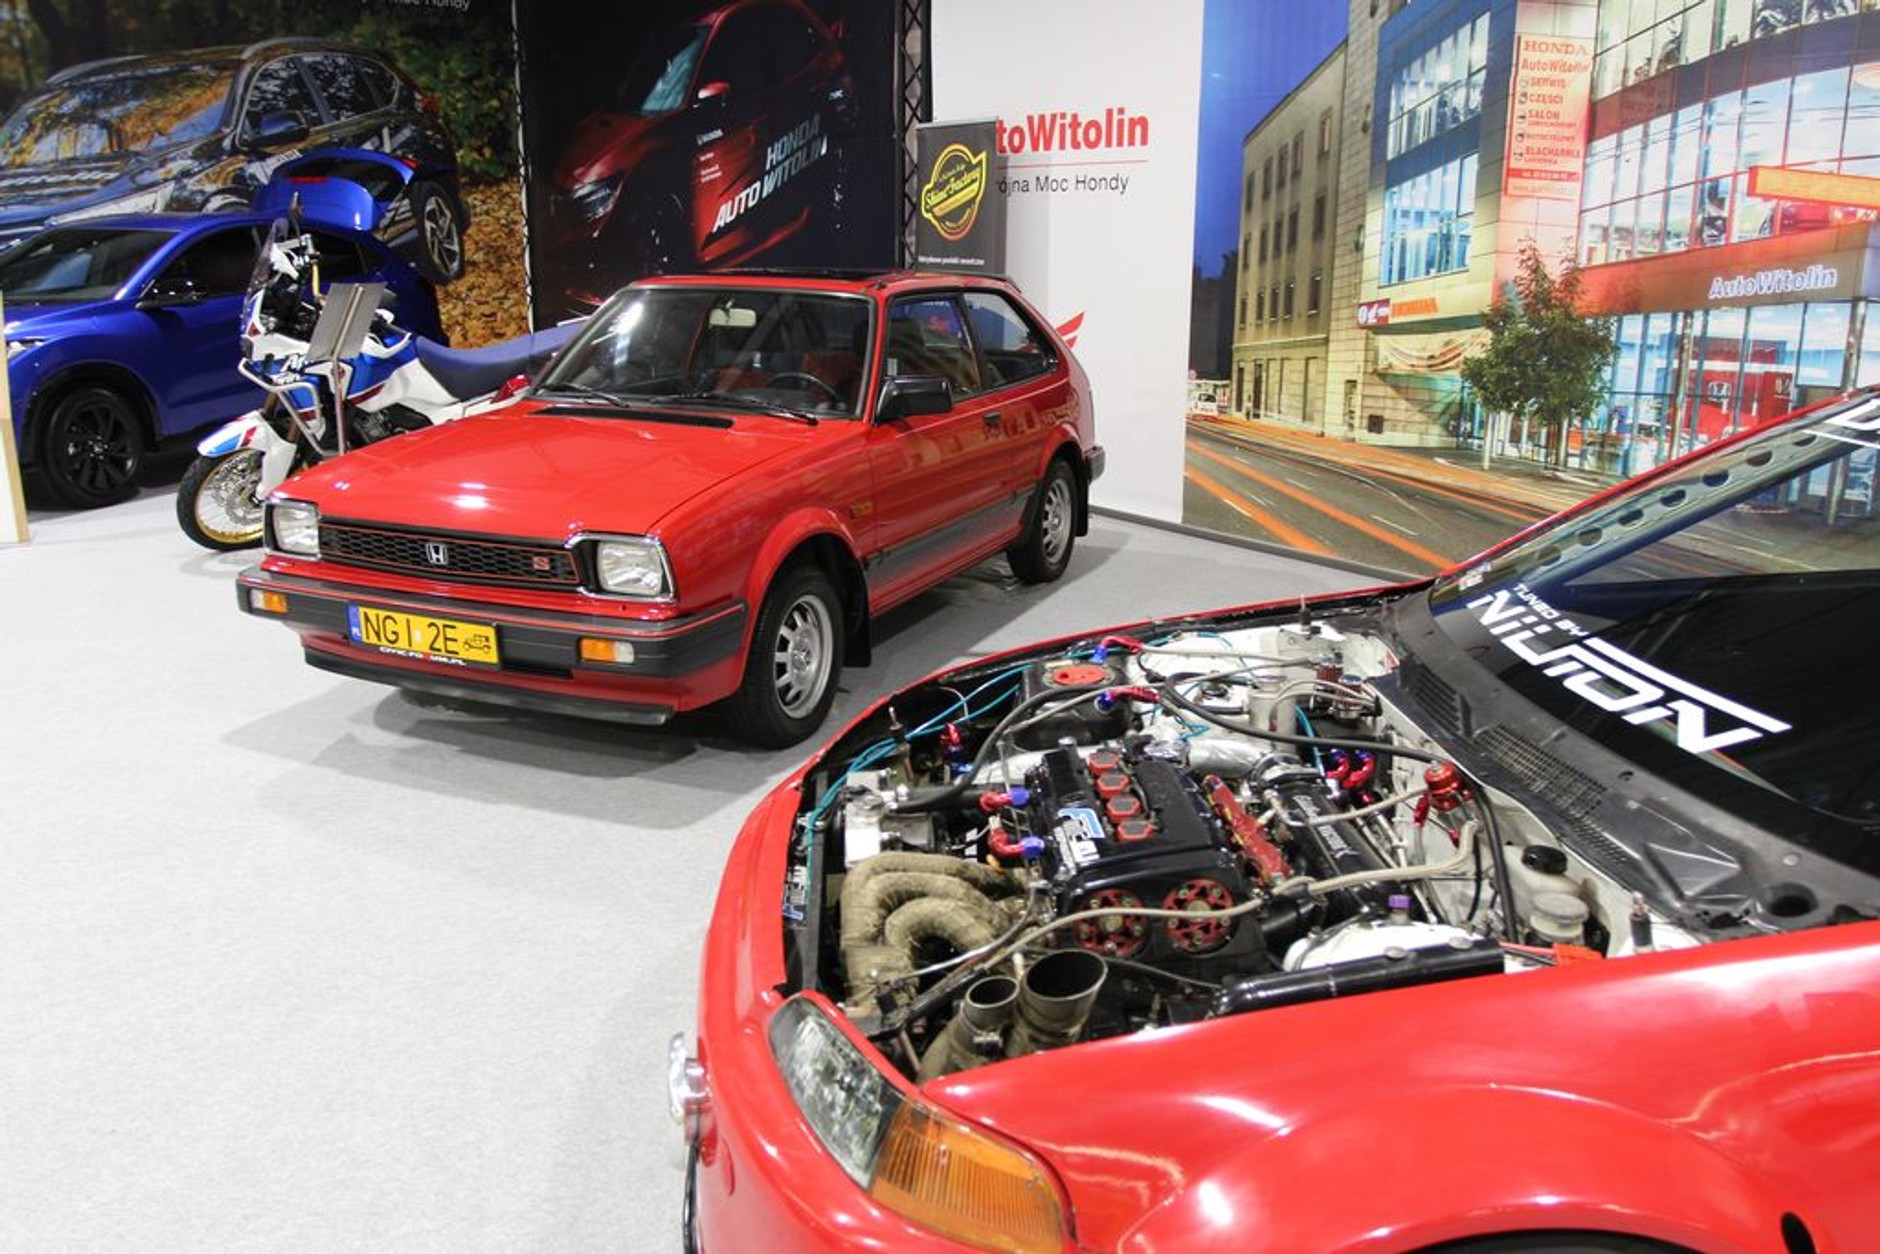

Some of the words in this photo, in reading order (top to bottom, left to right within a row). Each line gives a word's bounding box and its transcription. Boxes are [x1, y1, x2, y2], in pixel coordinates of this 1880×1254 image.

[1523, 40, 1588, 55] HONDA
[765, 112, 822, 171] HONDA
[712, 180, 762, 234] AUTO
[761, 134, 828, 199] WITOLIN
[1035, 177, 1068, 192] Moc
[1075, 174, 1128, 194] Hondy
[1708, 264, 1838, 299] AutoWitolin
[1513, 583, 1562, 621] TUNED
[1554, 619, 1590, 638] BY
[428, 622, 460, 655] 2E
